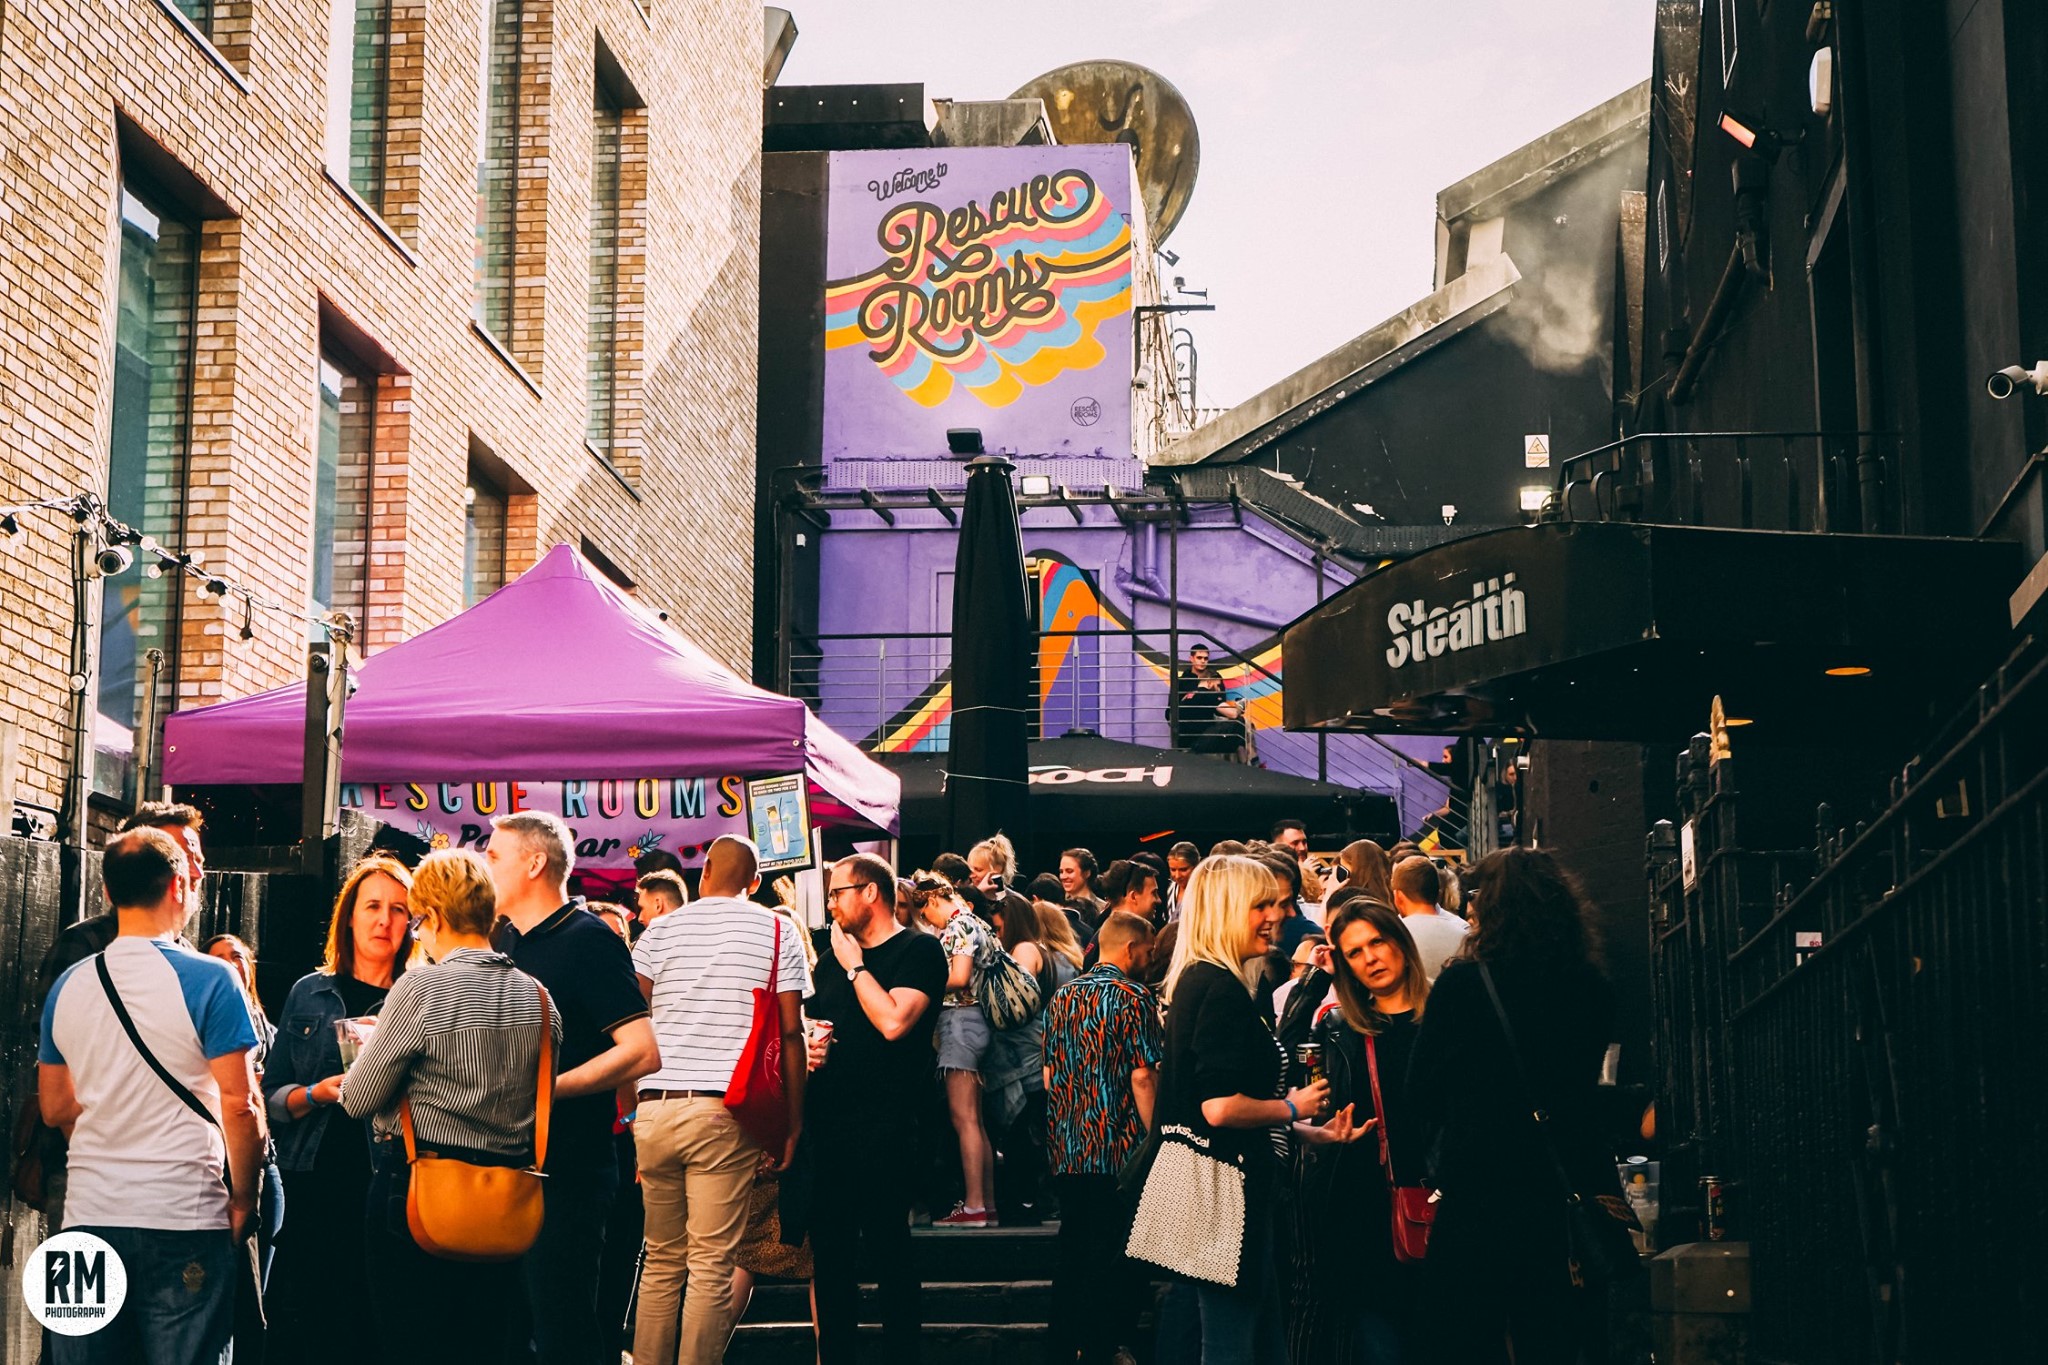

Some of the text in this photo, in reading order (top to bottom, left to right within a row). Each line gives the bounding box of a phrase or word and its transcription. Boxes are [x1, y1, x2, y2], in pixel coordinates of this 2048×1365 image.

[867, 162, 948, 201] Welcome to
[877, 168, 1096, 282] Rescue
[857, 249, 1056, 363] Rooms
[1386, 572, 1526, 669] Stealth
[562, 775, 744, 819] ROOMS
[1028, 766, 1173, 787] OCH
[571, 828, 621, 858] ar
